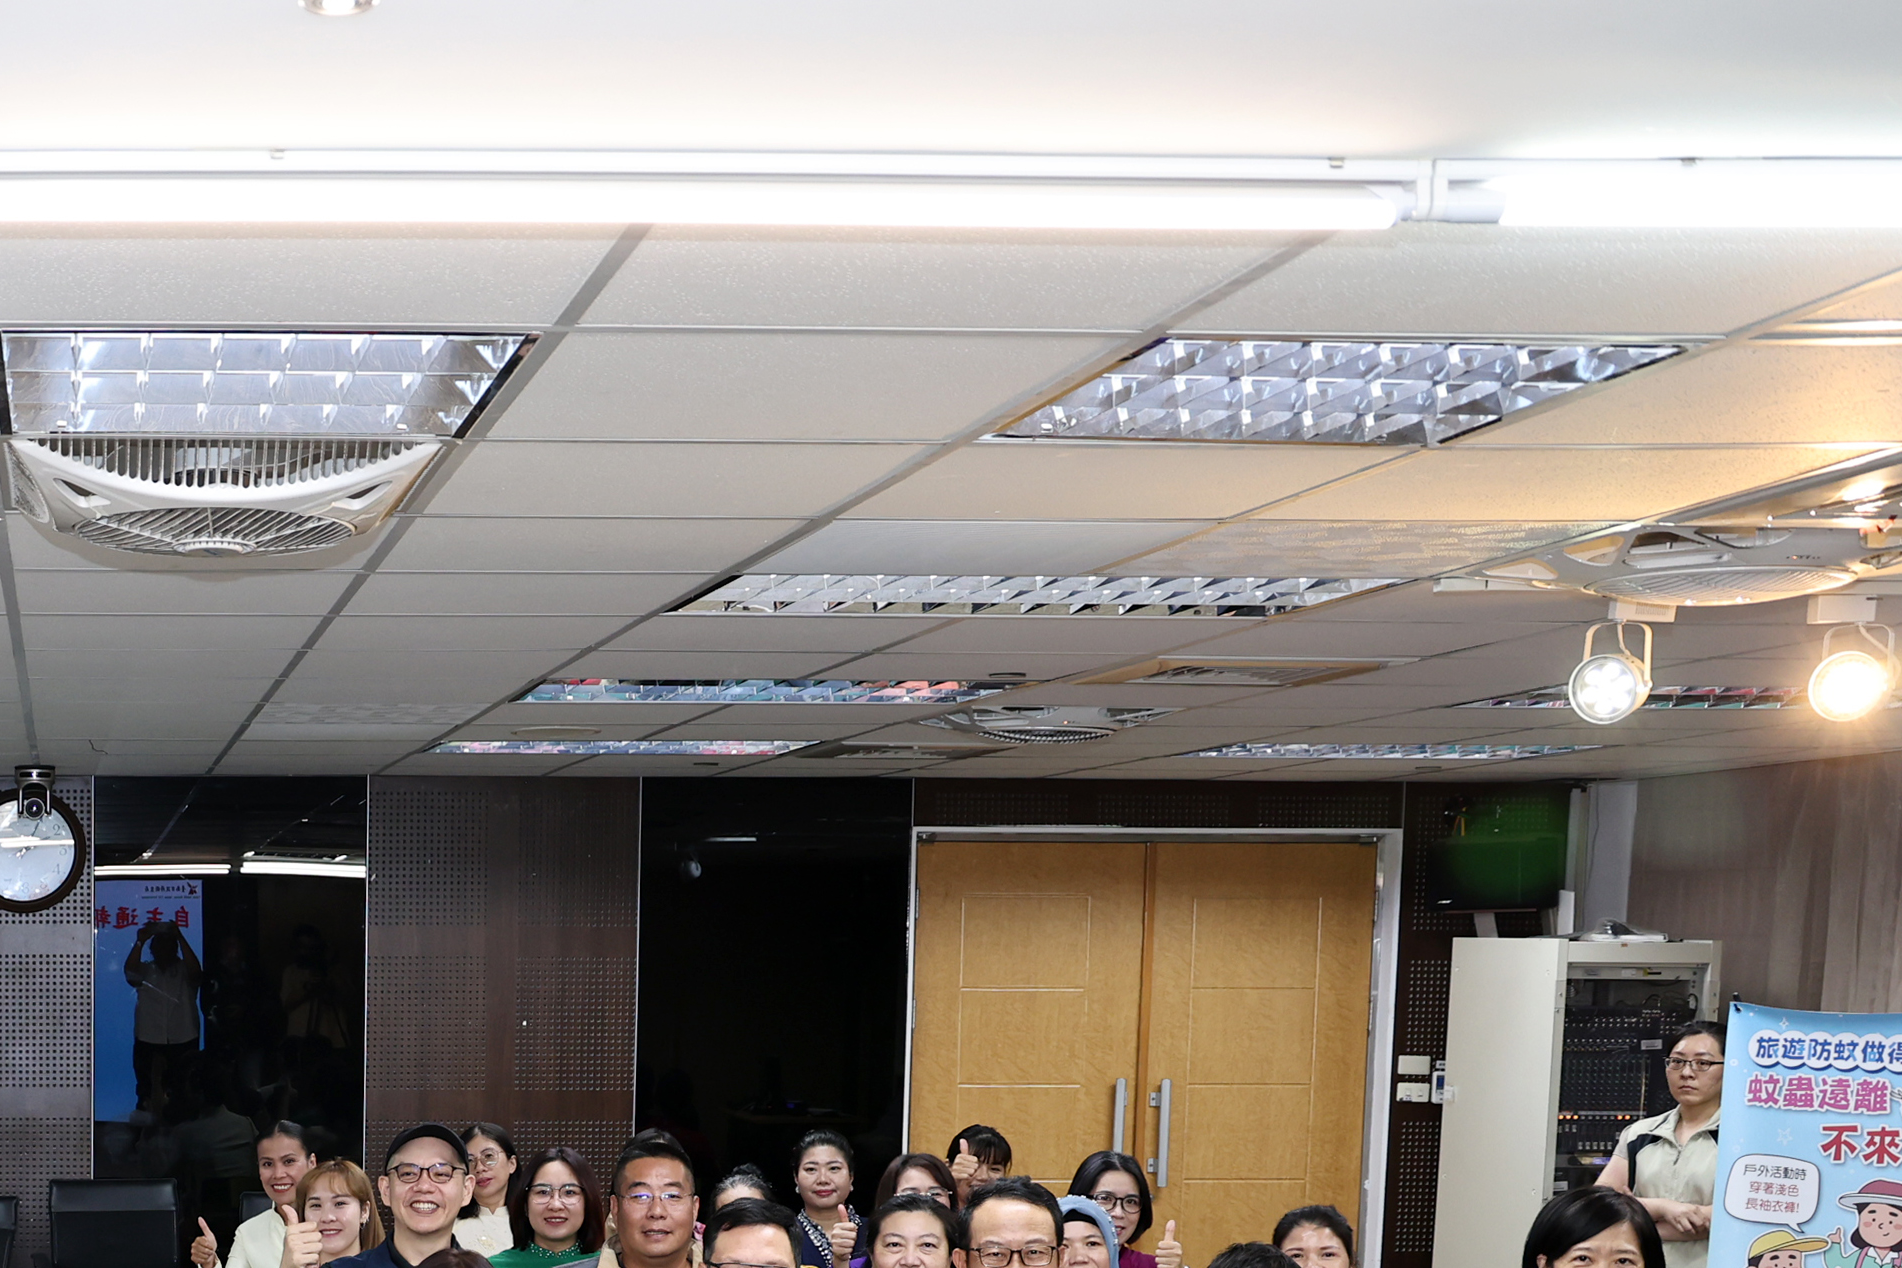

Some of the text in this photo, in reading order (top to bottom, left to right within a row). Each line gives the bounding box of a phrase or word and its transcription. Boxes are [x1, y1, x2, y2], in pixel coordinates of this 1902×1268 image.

[1747, 1072, 1890, 1113] 蚊蟲遠離
[1820, 1124, 1901, 1165] 不來
[1743, 1164, 1807, 1180] 戶外活動時
[1749, 1181, 1799, 1197] 穿著淺色
